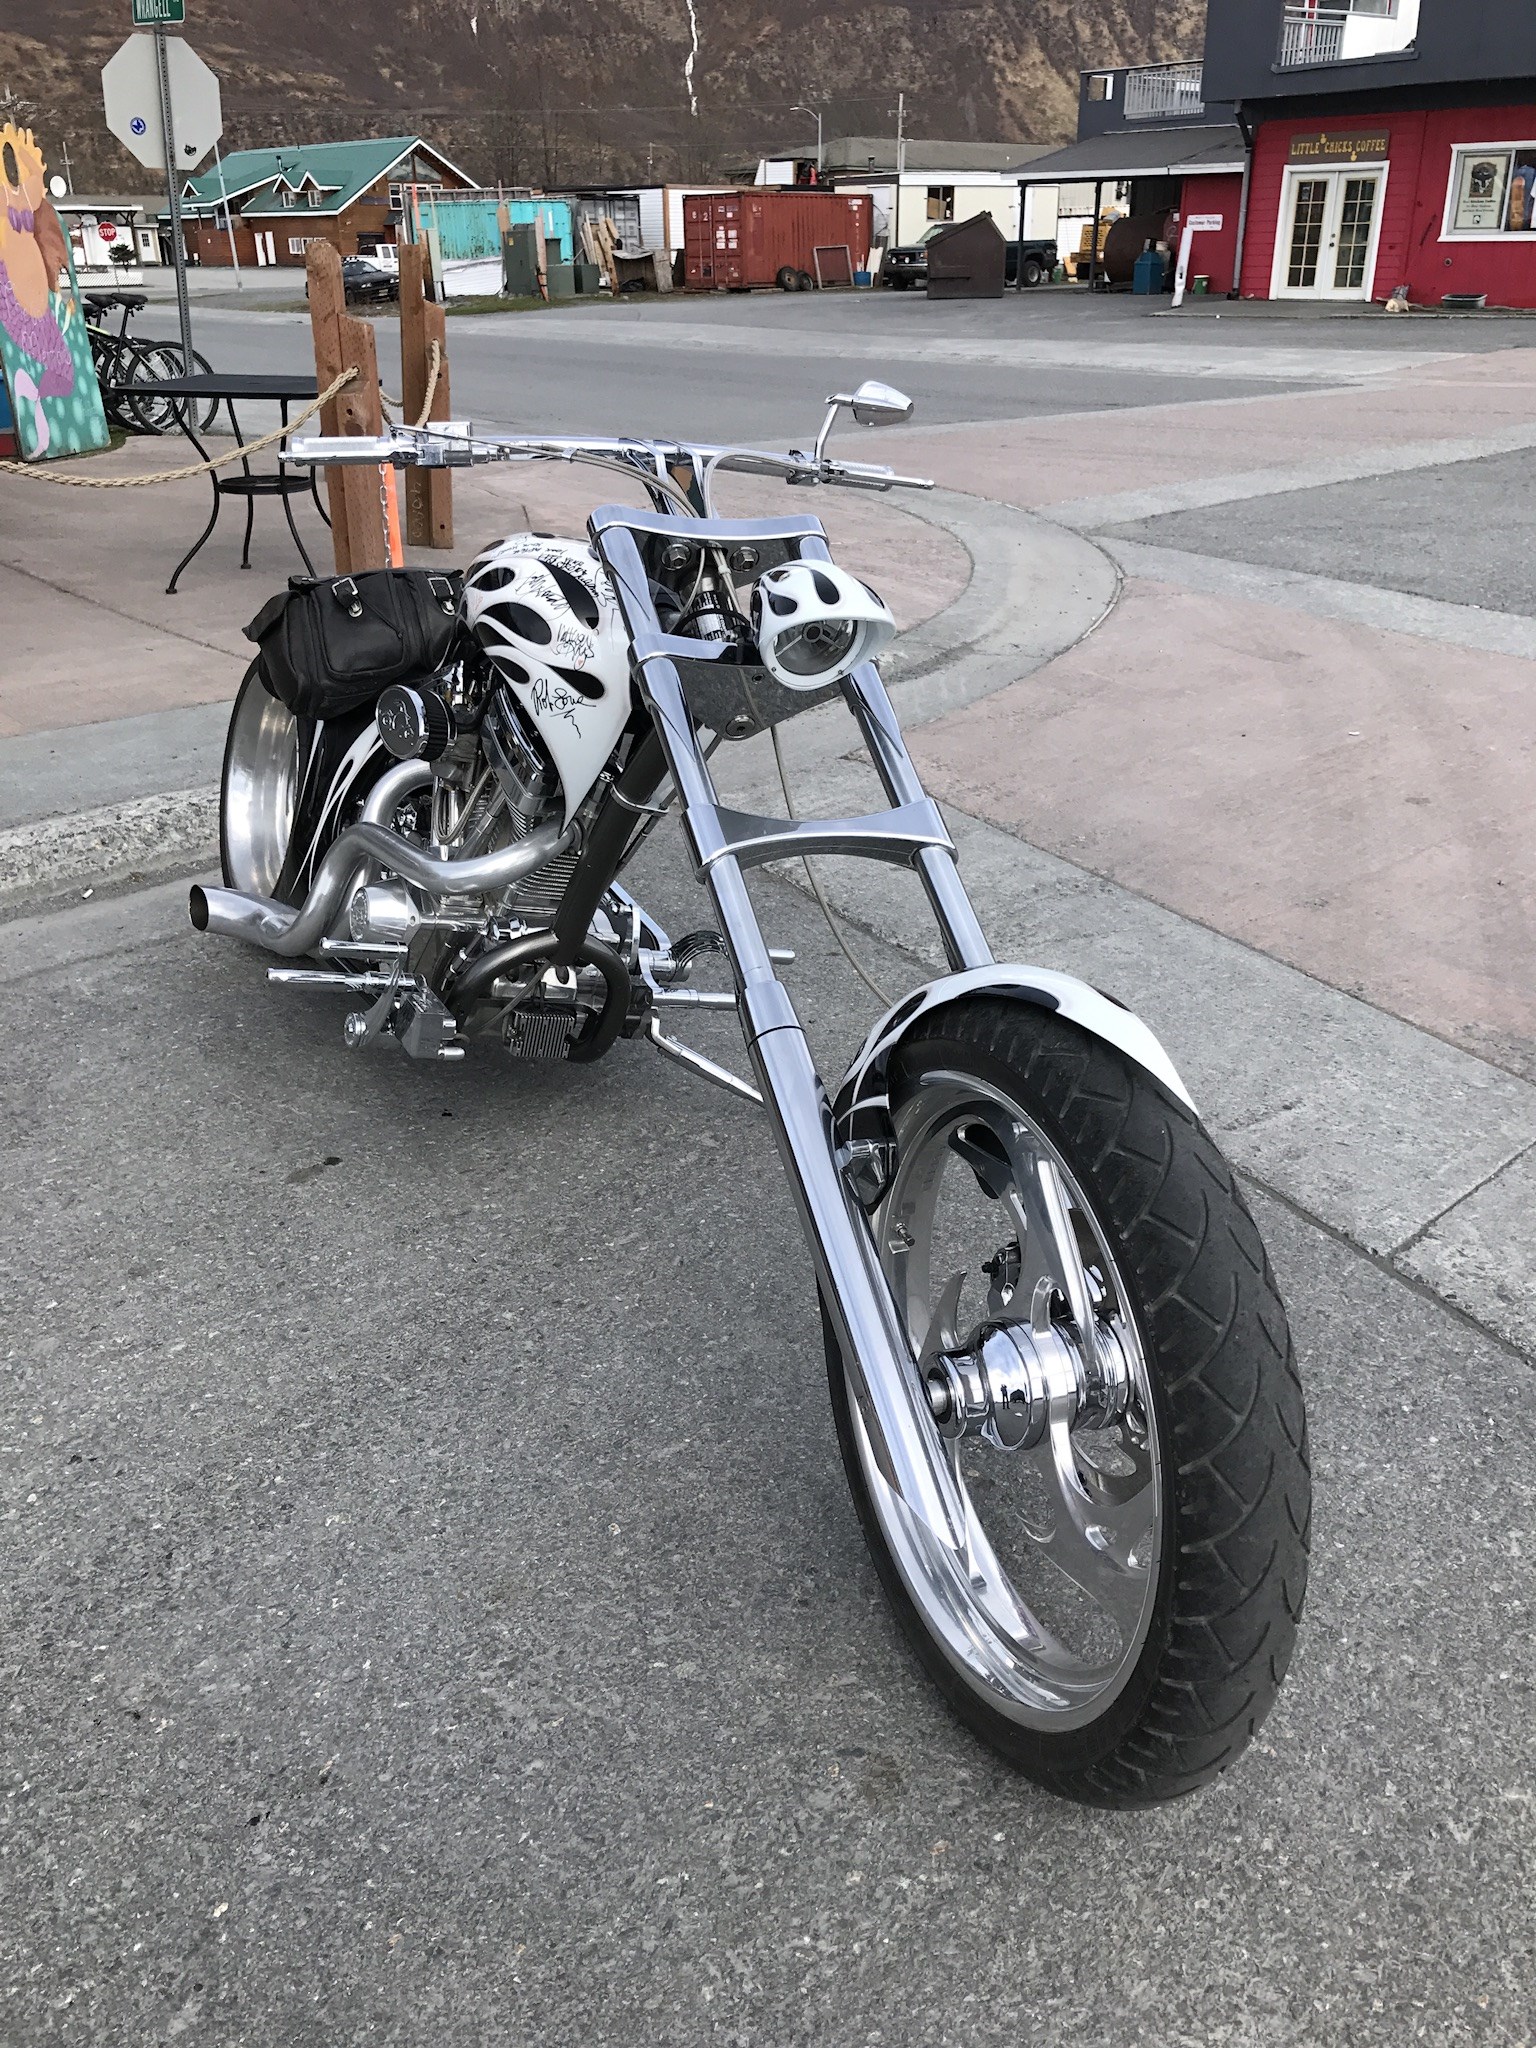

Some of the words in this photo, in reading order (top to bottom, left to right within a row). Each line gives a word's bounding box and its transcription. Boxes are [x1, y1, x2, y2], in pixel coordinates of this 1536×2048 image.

[136, 0, 170, 19] WRANGELL
[1291, 143, 1319, 155] LITTLE
[1324, 141, 1352, 153] CHICKS
[1356, 139, 1385, 152] COFFEE
[100, 228, 115, 236] STOP
